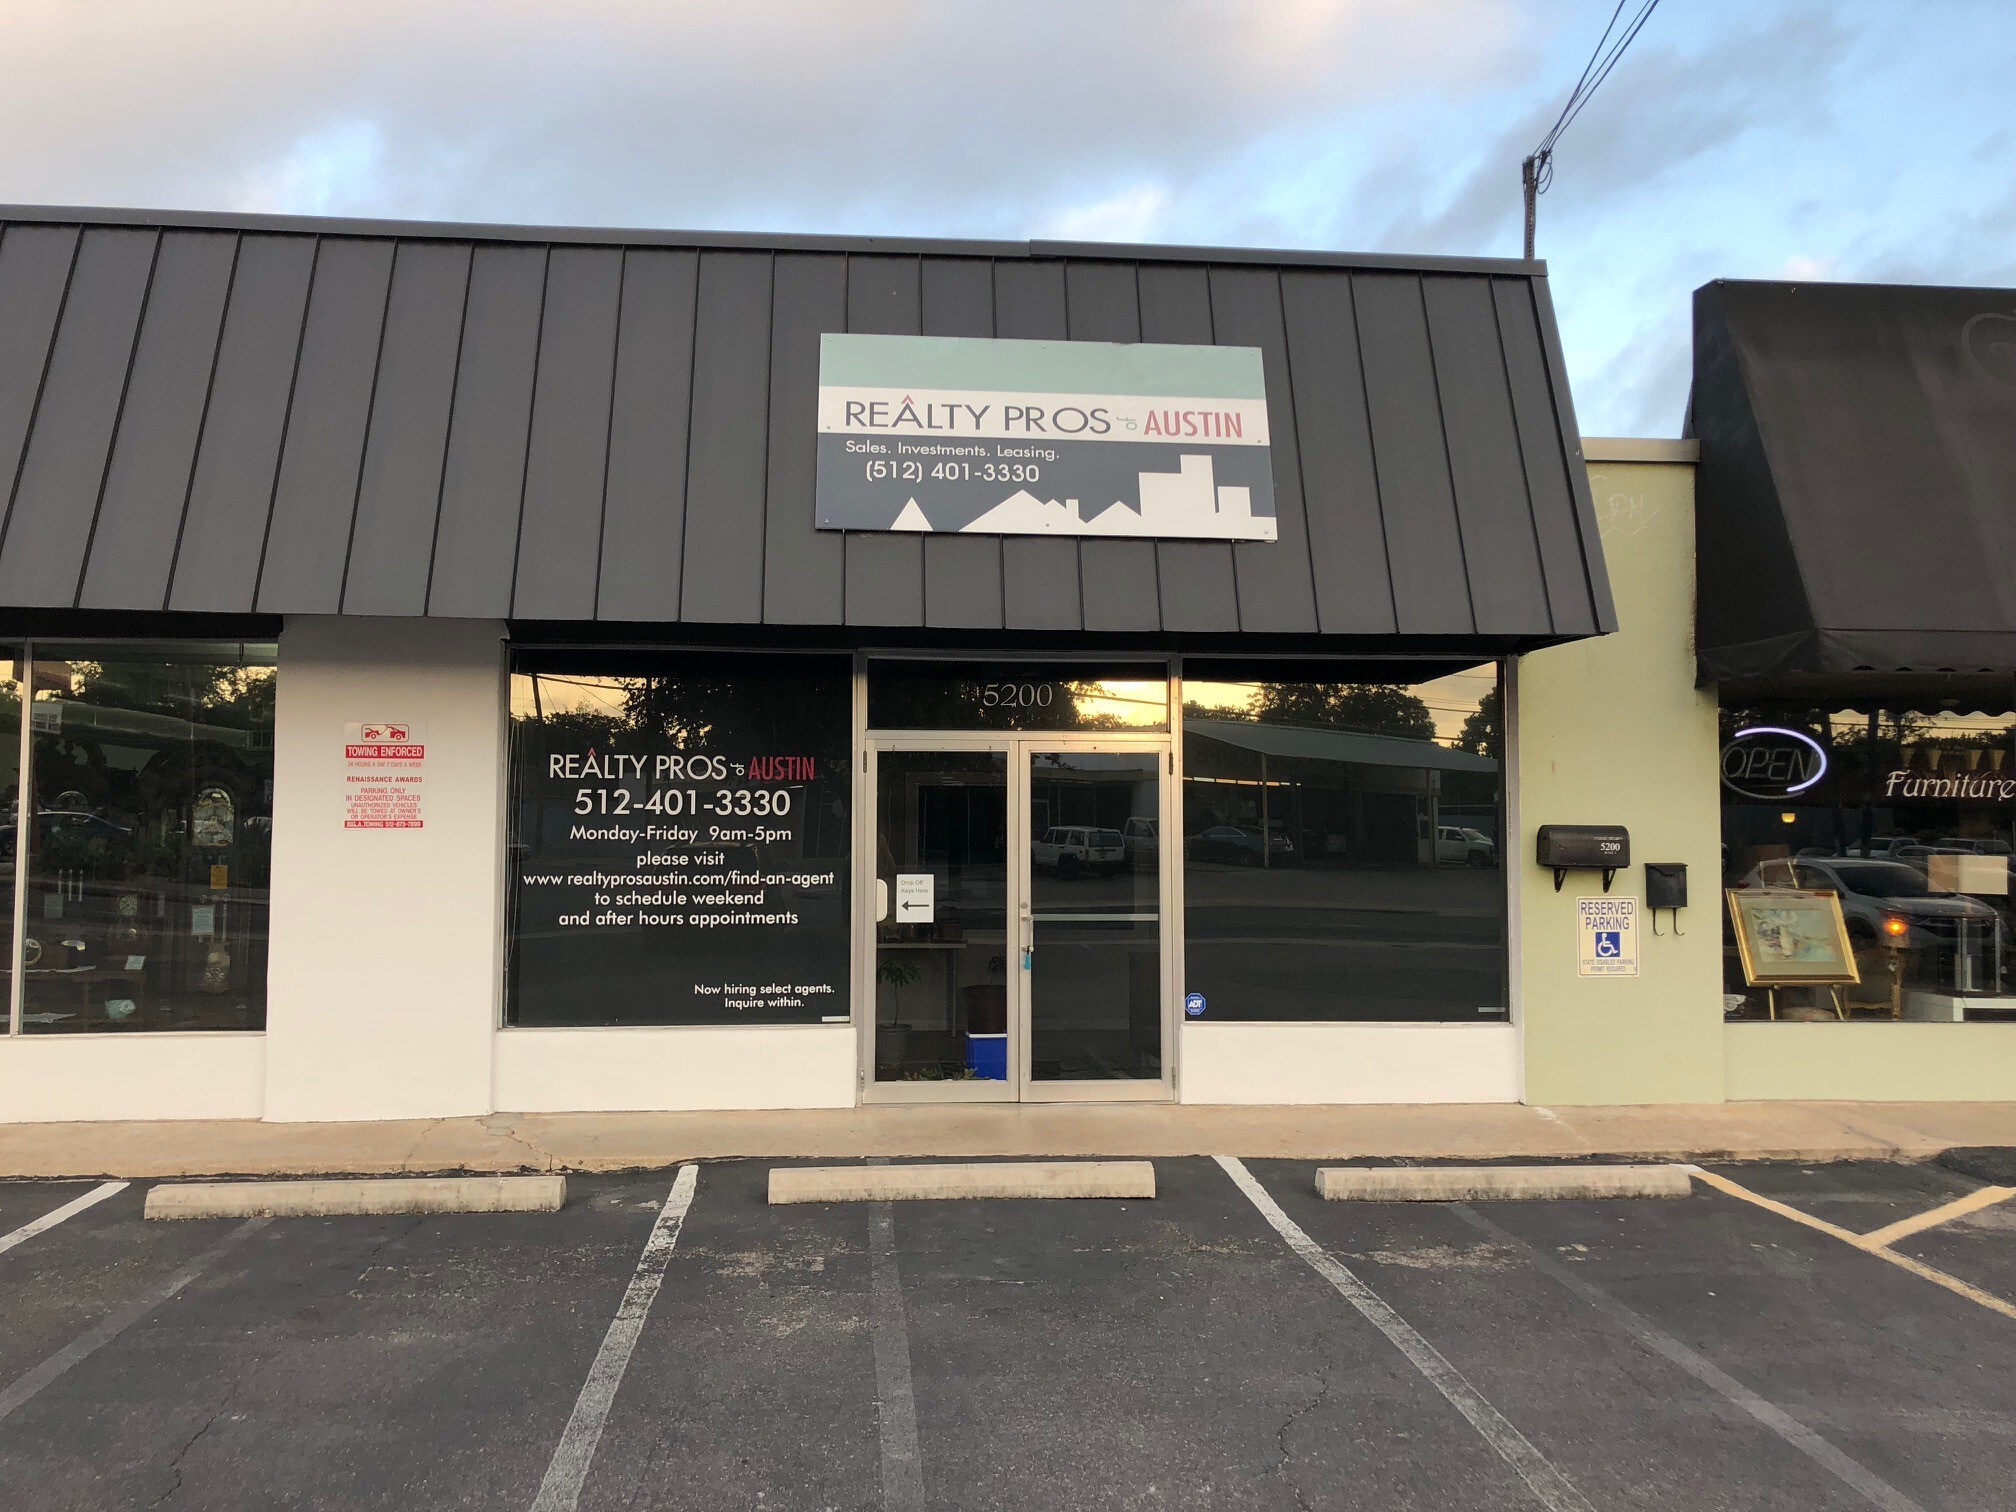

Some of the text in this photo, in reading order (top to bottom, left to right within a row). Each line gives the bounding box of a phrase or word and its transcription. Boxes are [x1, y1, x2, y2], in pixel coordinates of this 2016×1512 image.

[845, 394, 992, 431] REALTY
[1004, 405, 1112, 435] PROS
[1143, 410, 1243, 438] AUSTIN
[845, 440, 1060, 461] Sales. Investments. Leasing.
[866, 460, 1040, 483] (512) 401-3330
[982, 683, 1053, 708] 5200
[347, 746, 423, 757] TOWING ENFORCED
[549, 747, 648, 780] REALTY
[656, 755, 727, 780] PROS
[749, 756, 815, 781] AUSTIN
[1722, 746, 1815, 781] OPEN
[346, 775, 393, 783] RENAISSANCE
[1885, 769, 2016, 802] Furniture
[346, 794, 421, 802] IN DESIGNATED SPACES
[574, 789, 791, 816] 512-401-3330
[569, 825, 792, 844] Monday-Friday 9am-5pm
[1600, 842, 1621, 852] 5200
[636, 852, 725, 869] please visit
[594, 890, 764, 906] to schedule weekend
[1580, 901, 1634, 916] RESERVED
[558, 911, 799, 928] and after hours appointments
[1585, 916, 1630, 930] PARKING
[694, 984, 835, 997] Now hiring select agents.
[725, 996, 805, 1009] Inquire within.
[1187, 1000, 1203, 1008] ADT
